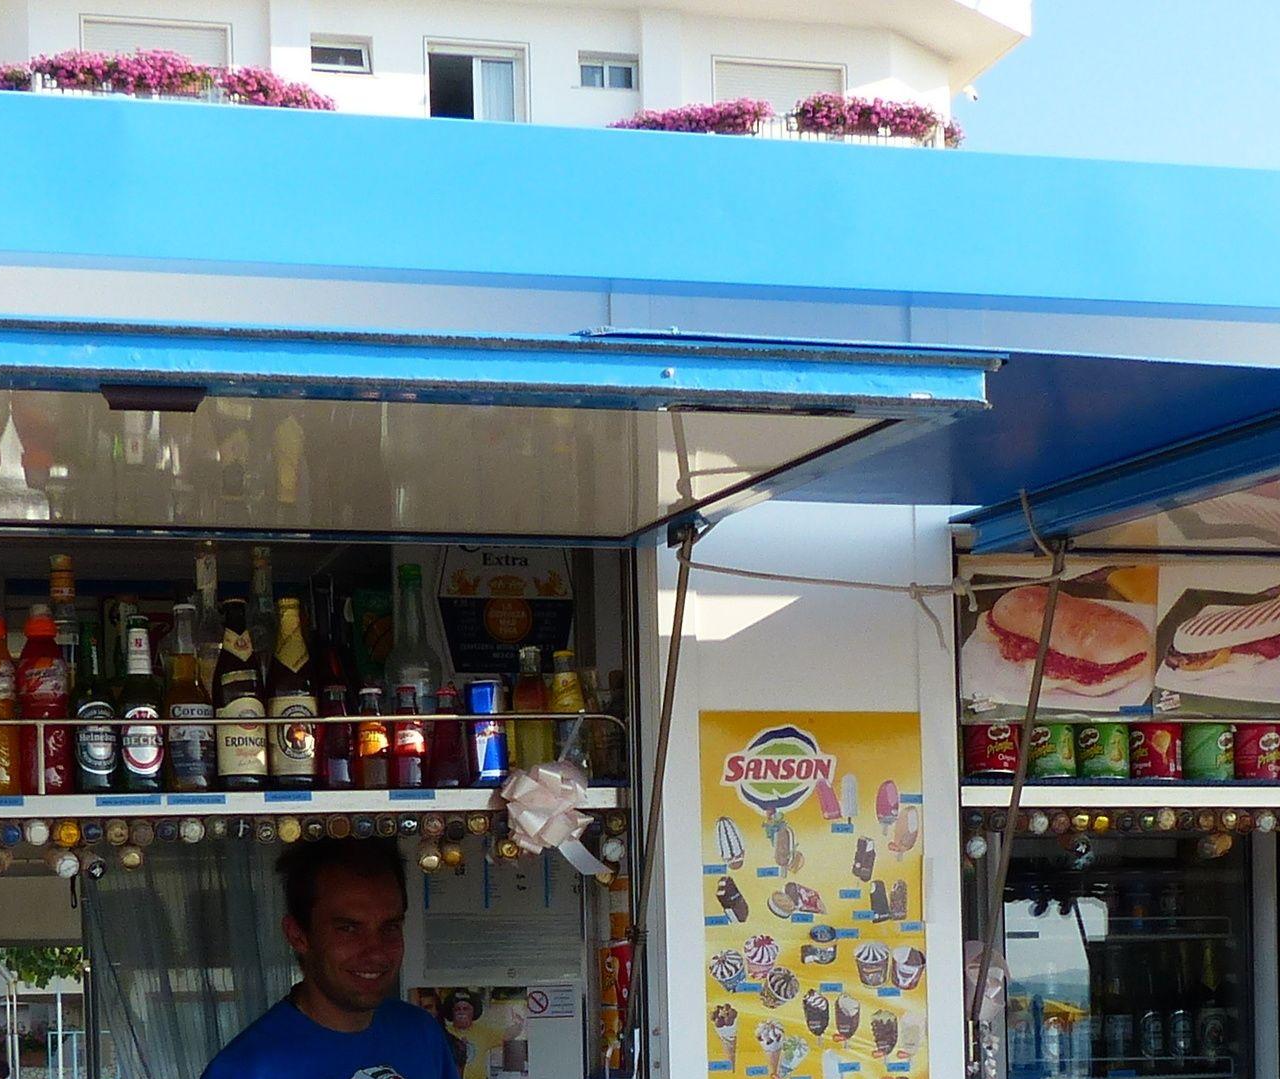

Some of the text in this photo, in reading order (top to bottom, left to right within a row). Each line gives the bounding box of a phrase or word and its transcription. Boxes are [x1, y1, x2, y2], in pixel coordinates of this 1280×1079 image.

[482, 552, 528, 566] Extra
[172, 706, 210, 717] Coron
[225, 736, 265, 747] ERDINGE
[725, 755, 831, 782] SANSON
